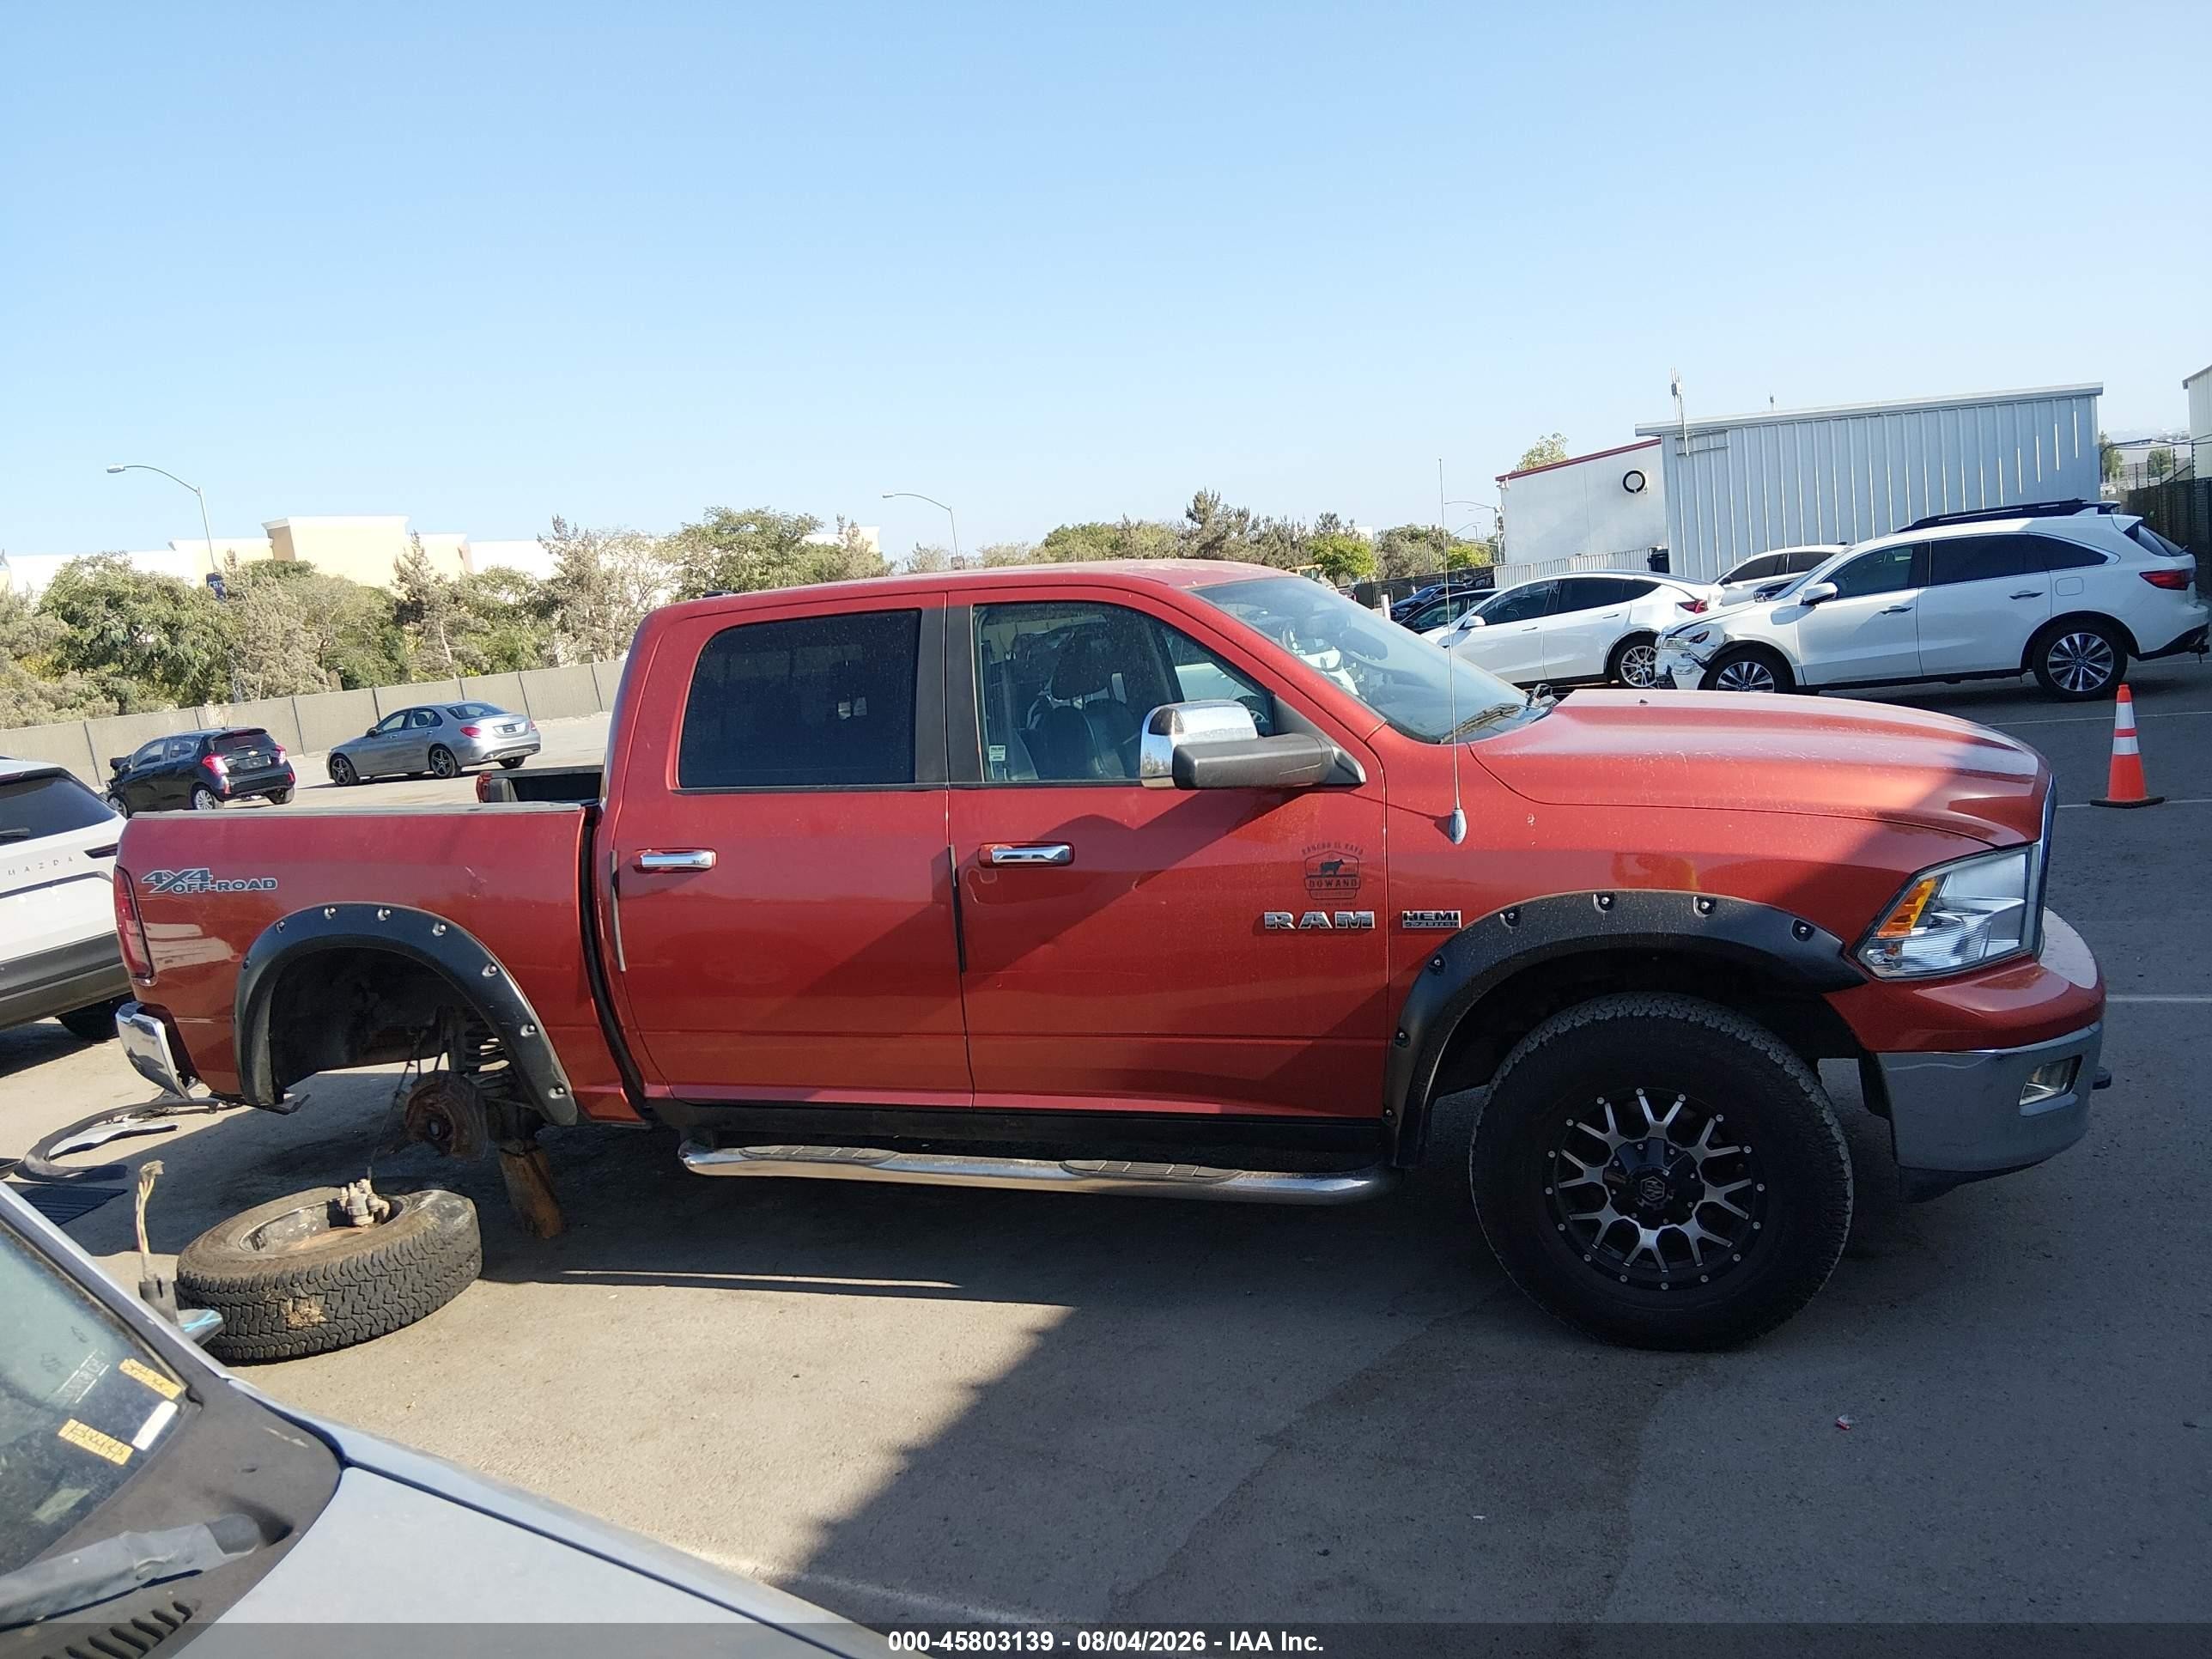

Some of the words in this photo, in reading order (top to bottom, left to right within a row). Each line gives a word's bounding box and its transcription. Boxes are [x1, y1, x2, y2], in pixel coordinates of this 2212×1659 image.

[8, 857, 73, 876] MAZDA
[172, 878, 278, 894] OFF-ROAD
[1264, 911, 1375, 930] RAM
[1403, 911, 1460, 921] HEMI
